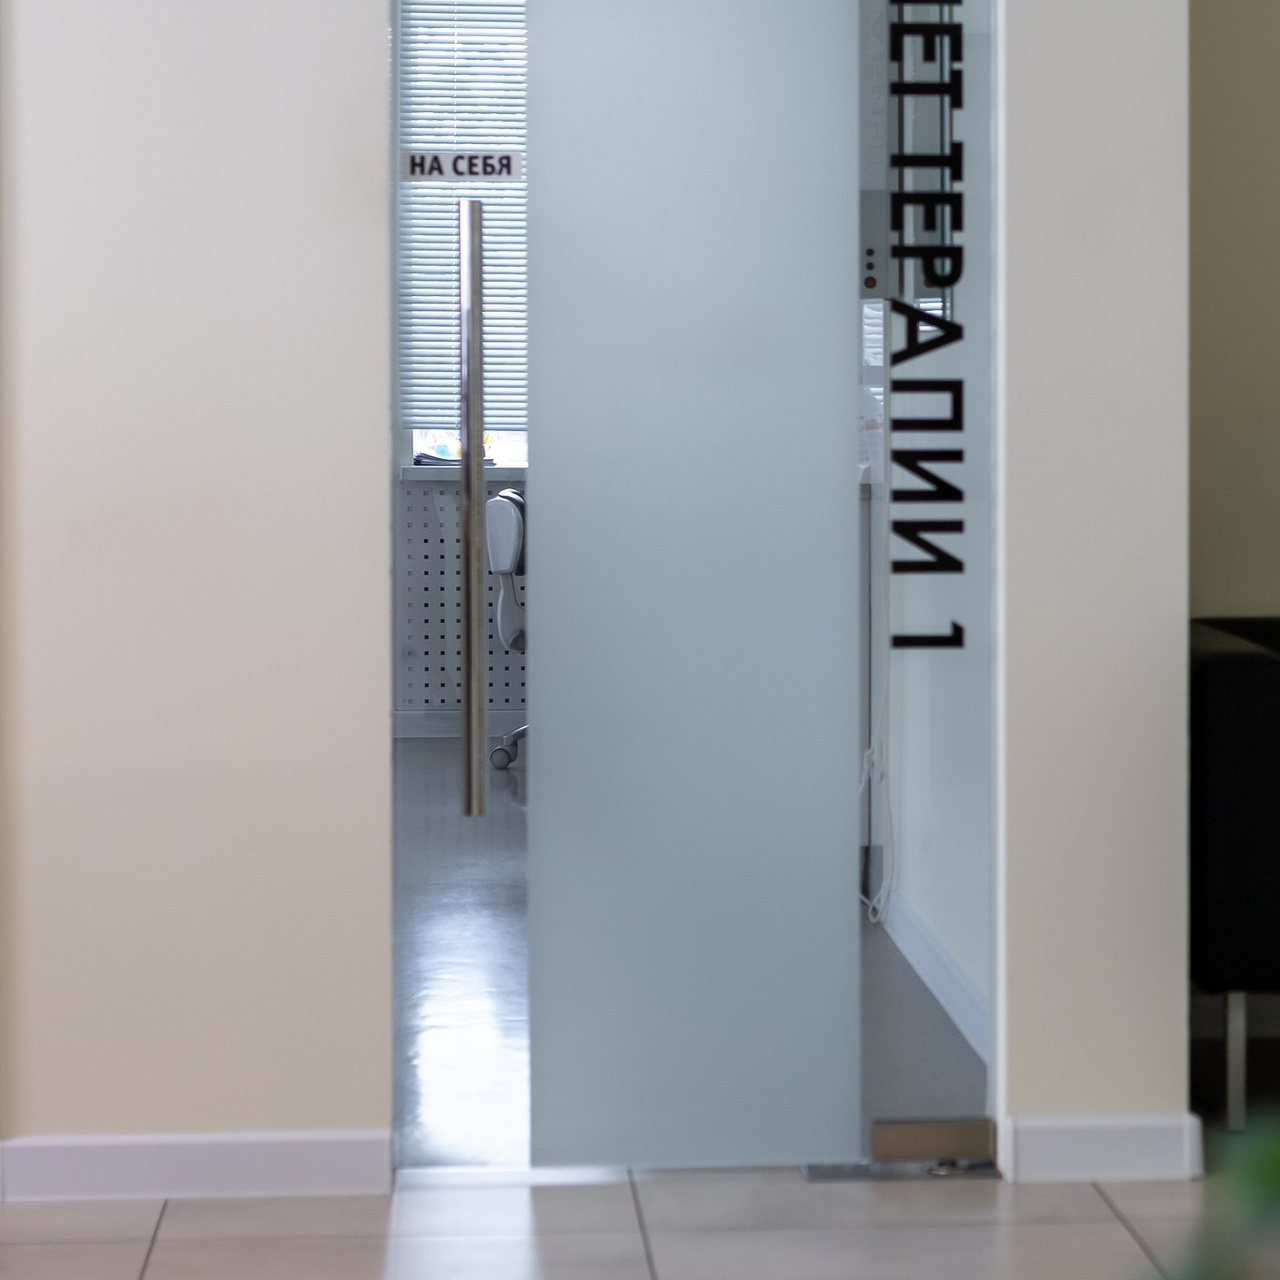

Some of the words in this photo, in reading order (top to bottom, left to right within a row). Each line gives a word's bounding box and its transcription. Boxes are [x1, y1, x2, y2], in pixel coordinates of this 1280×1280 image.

[409, 154, 444, 176] НА
[451, 154, 512, 176] СЕБЯ
[888, 139, 966, 576] ТЕРАПИИ
[890, 619, 966, 651] 1
